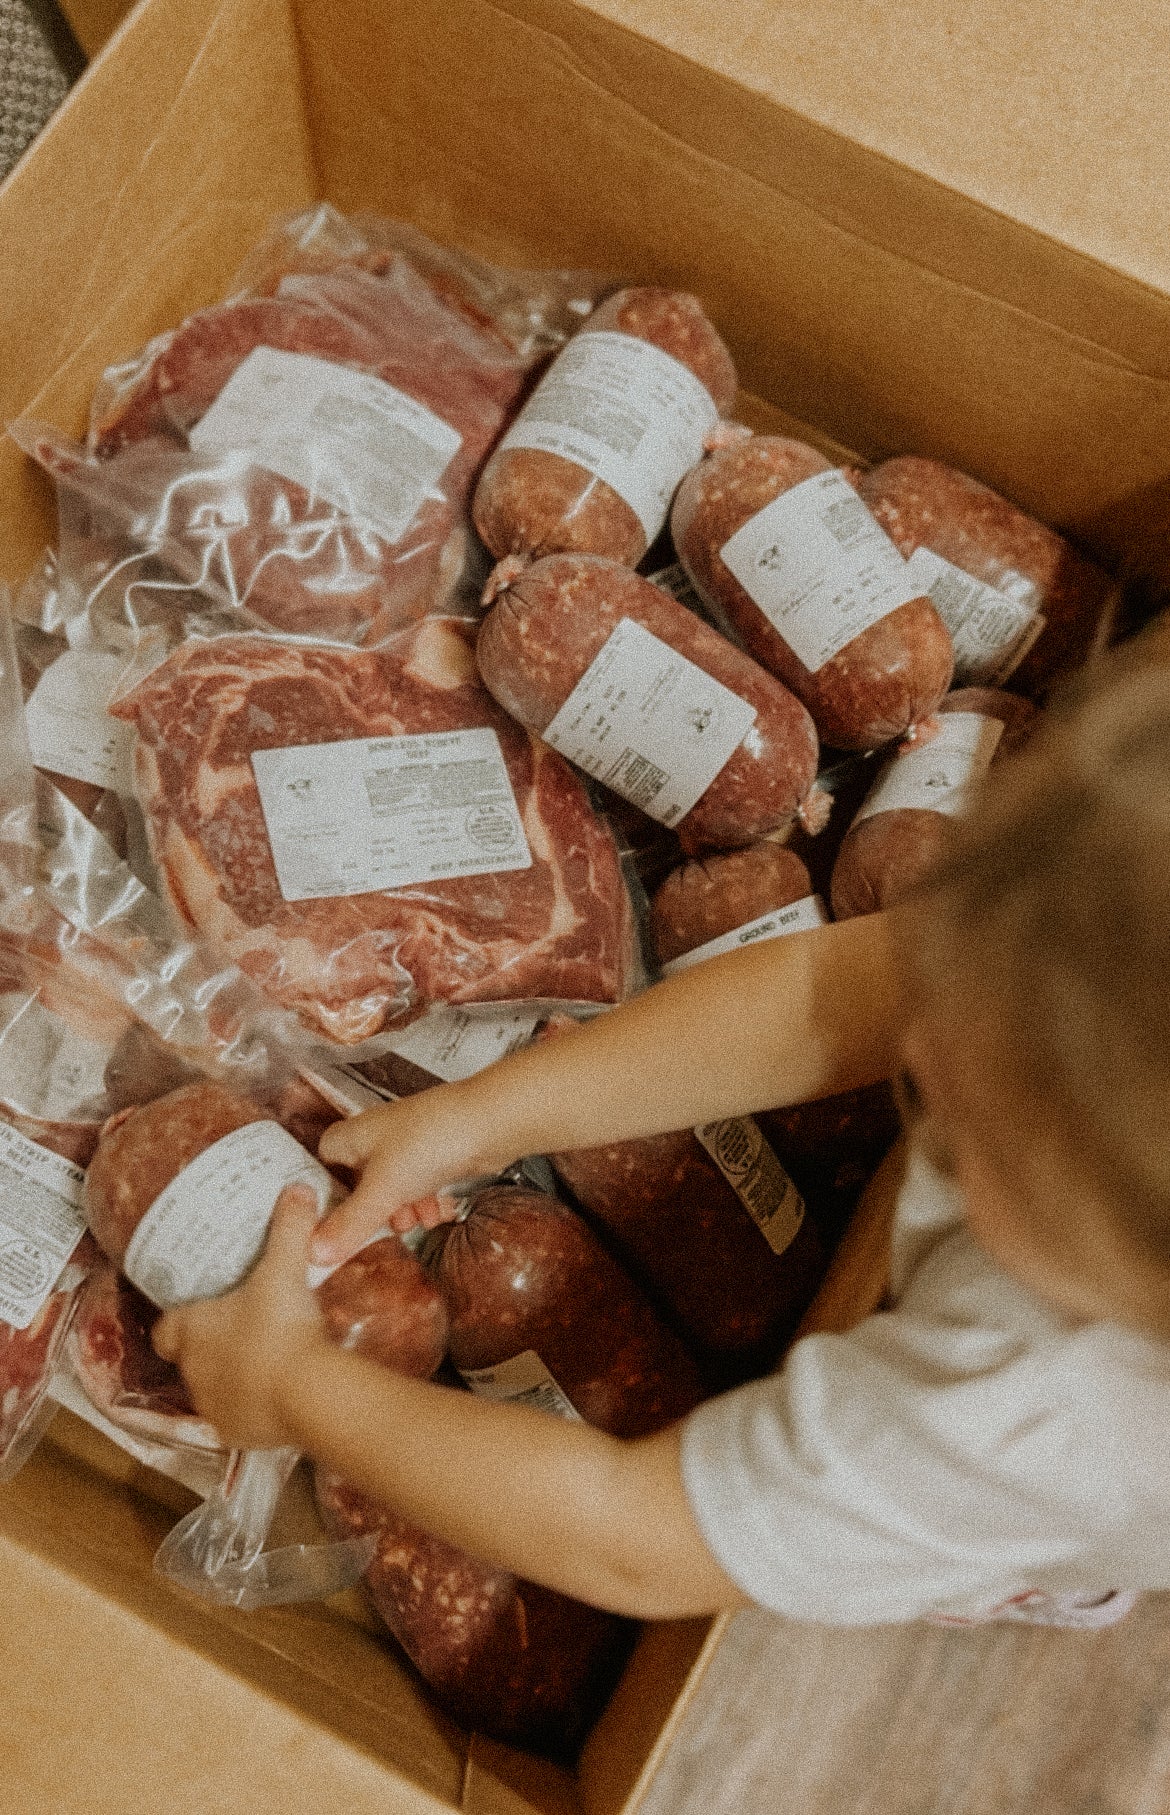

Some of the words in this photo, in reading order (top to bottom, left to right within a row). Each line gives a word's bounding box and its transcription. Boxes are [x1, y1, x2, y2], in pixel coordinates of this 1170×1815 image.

[739, 920, 776, 943] GROUND
[779, 908, 800, 926] BEEF
[16, 1140, 49, 1163] STRIP
